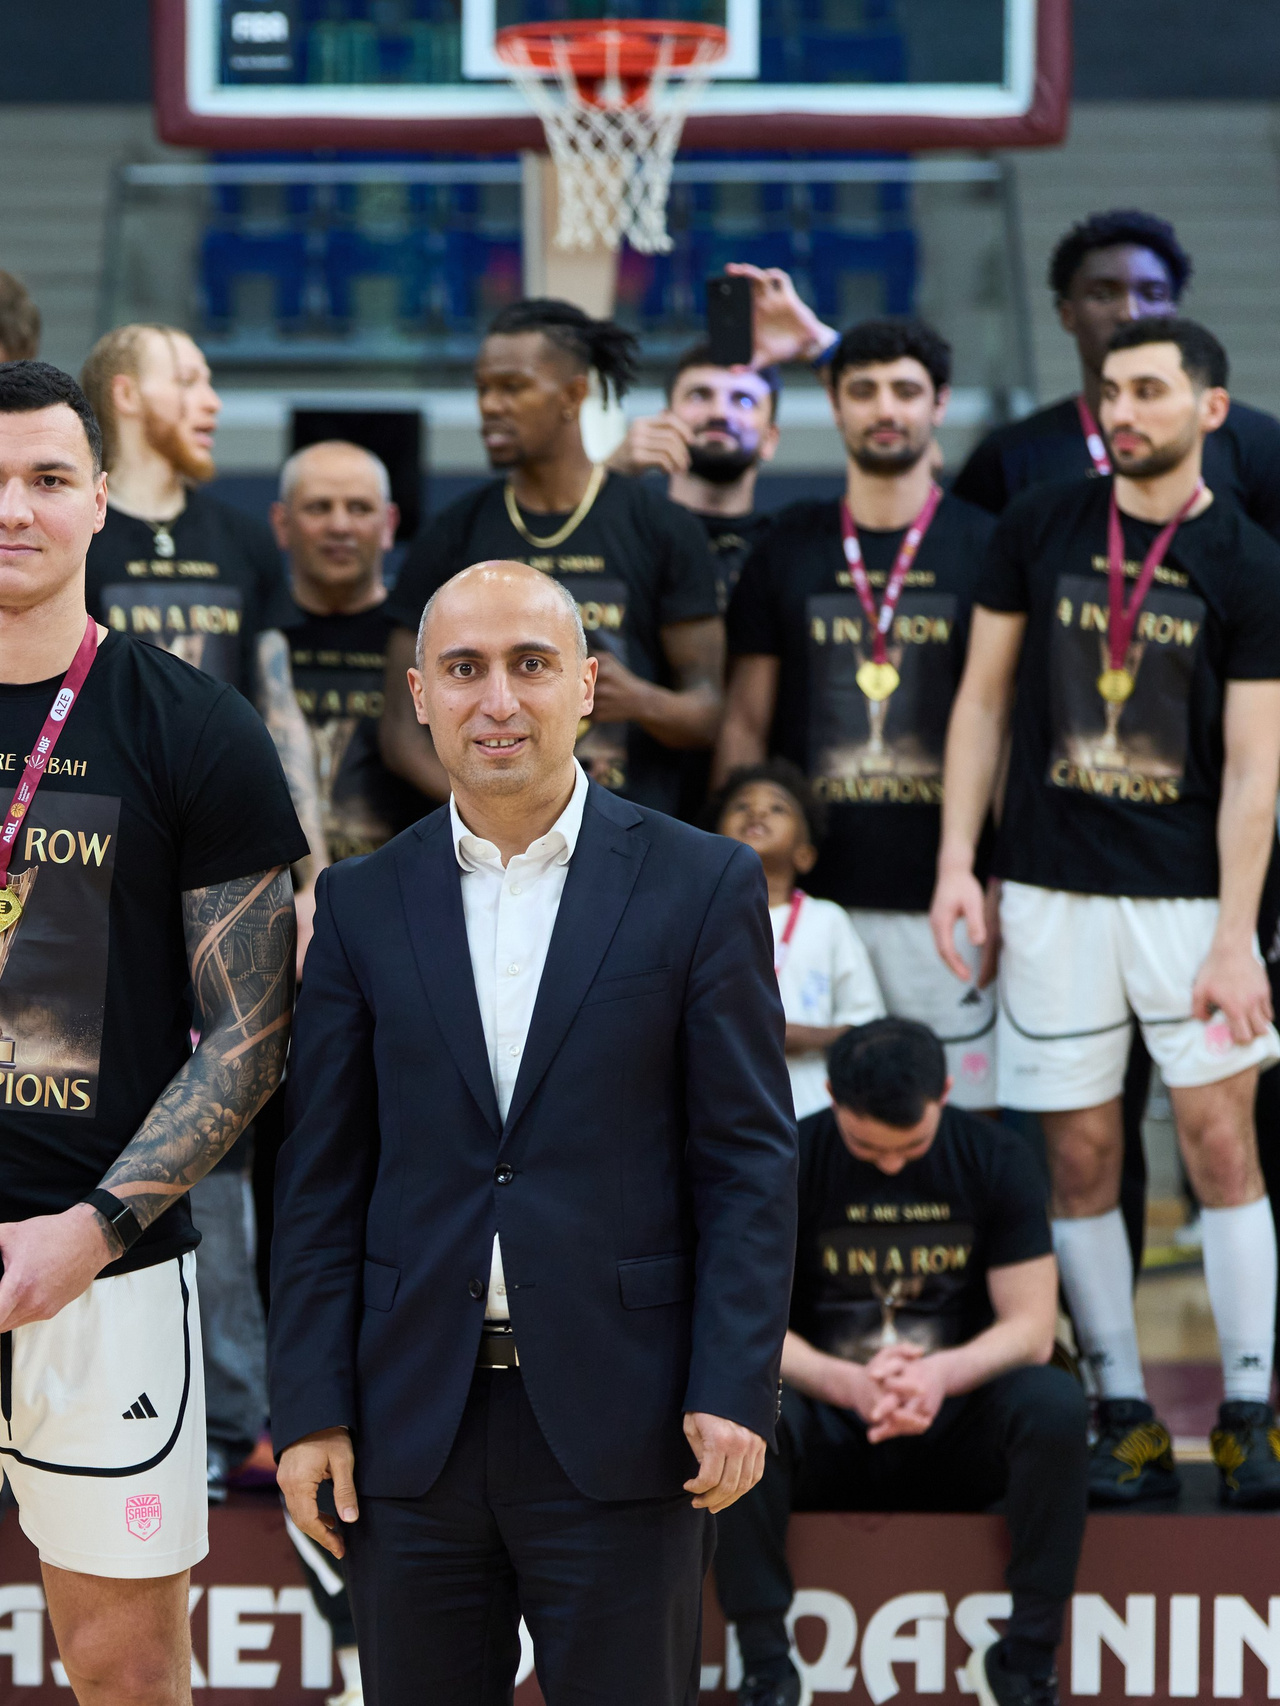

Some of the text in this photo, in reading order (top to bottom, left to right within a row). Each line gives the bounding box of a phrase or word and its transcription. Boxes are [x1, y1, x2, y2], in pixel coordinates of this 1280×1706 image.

[54, 693, 71, 717] AZE
[36, 735, 51, 755] ABF
[2, 819, 20, 844] ABL
[24, 827, 112, 867] ROW
[129, 1506, 159, 1520] SABAH
